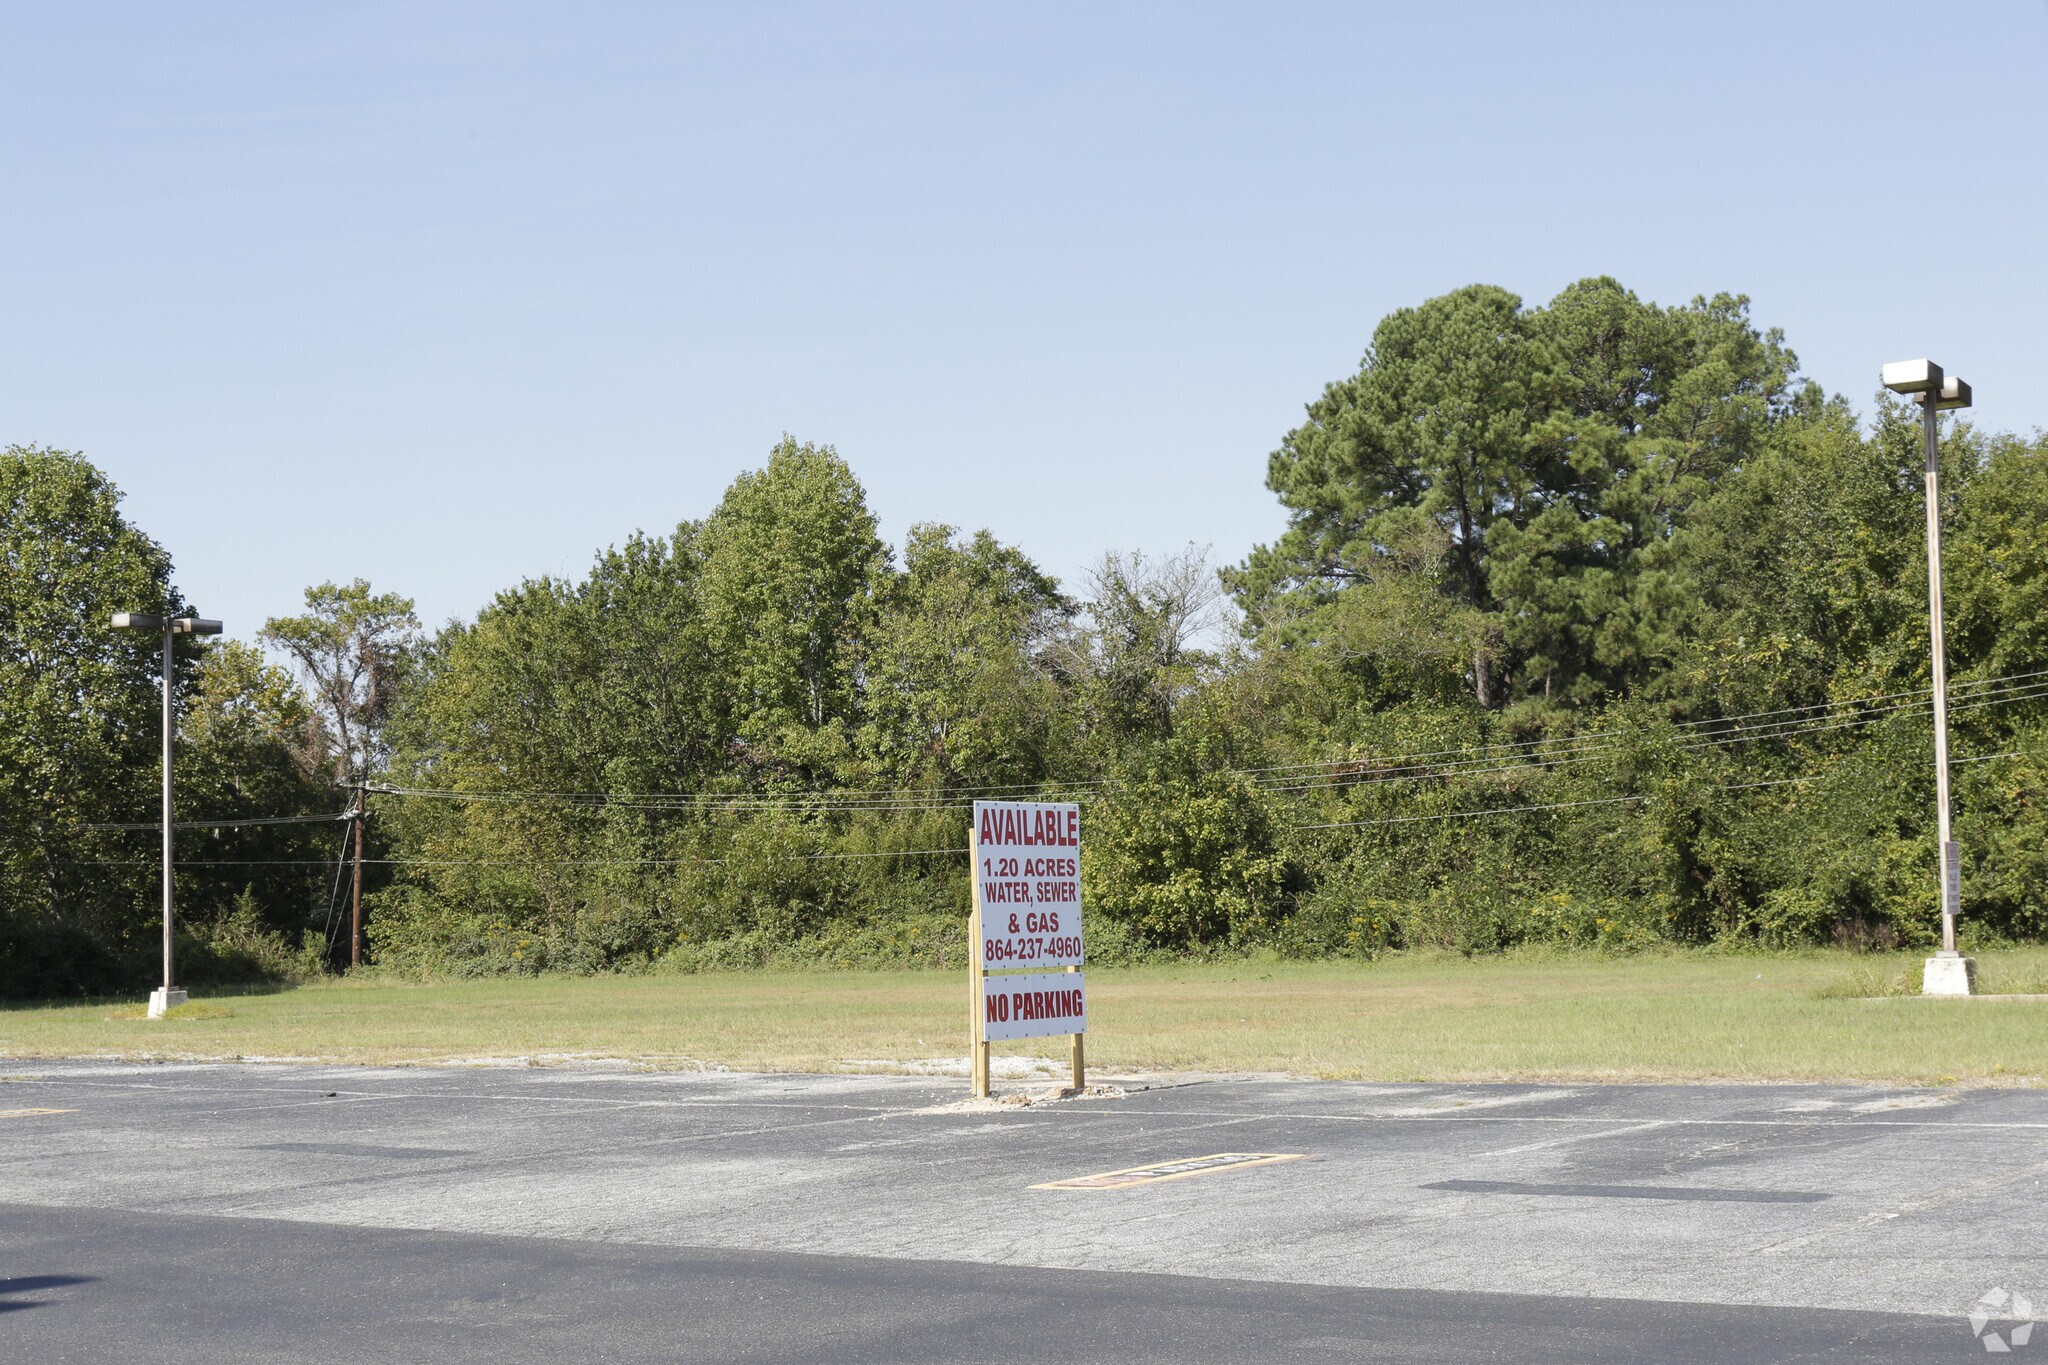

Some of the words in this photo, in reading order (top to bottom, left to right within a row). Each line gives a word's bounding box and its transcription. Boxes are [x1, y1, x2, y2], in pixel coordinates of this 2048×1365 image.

[981, 809, 1077, 846] AVAILABLE
[984, 858, 1018, 877] 1.20
[1024, 858, 1076, 877] ACRES
[985, 881, 1033, 907] WATER,
[1037, 881, 1076, 902] SEWER
[1008, 913, 1020, 934] &
[1027, 912, 1059, 933] GAS
[986, 936, 1081, 961] 864-237-4960
[986, 993, 1009, 1022] NO
[1013, 989, 1083, 1020] PARKING
